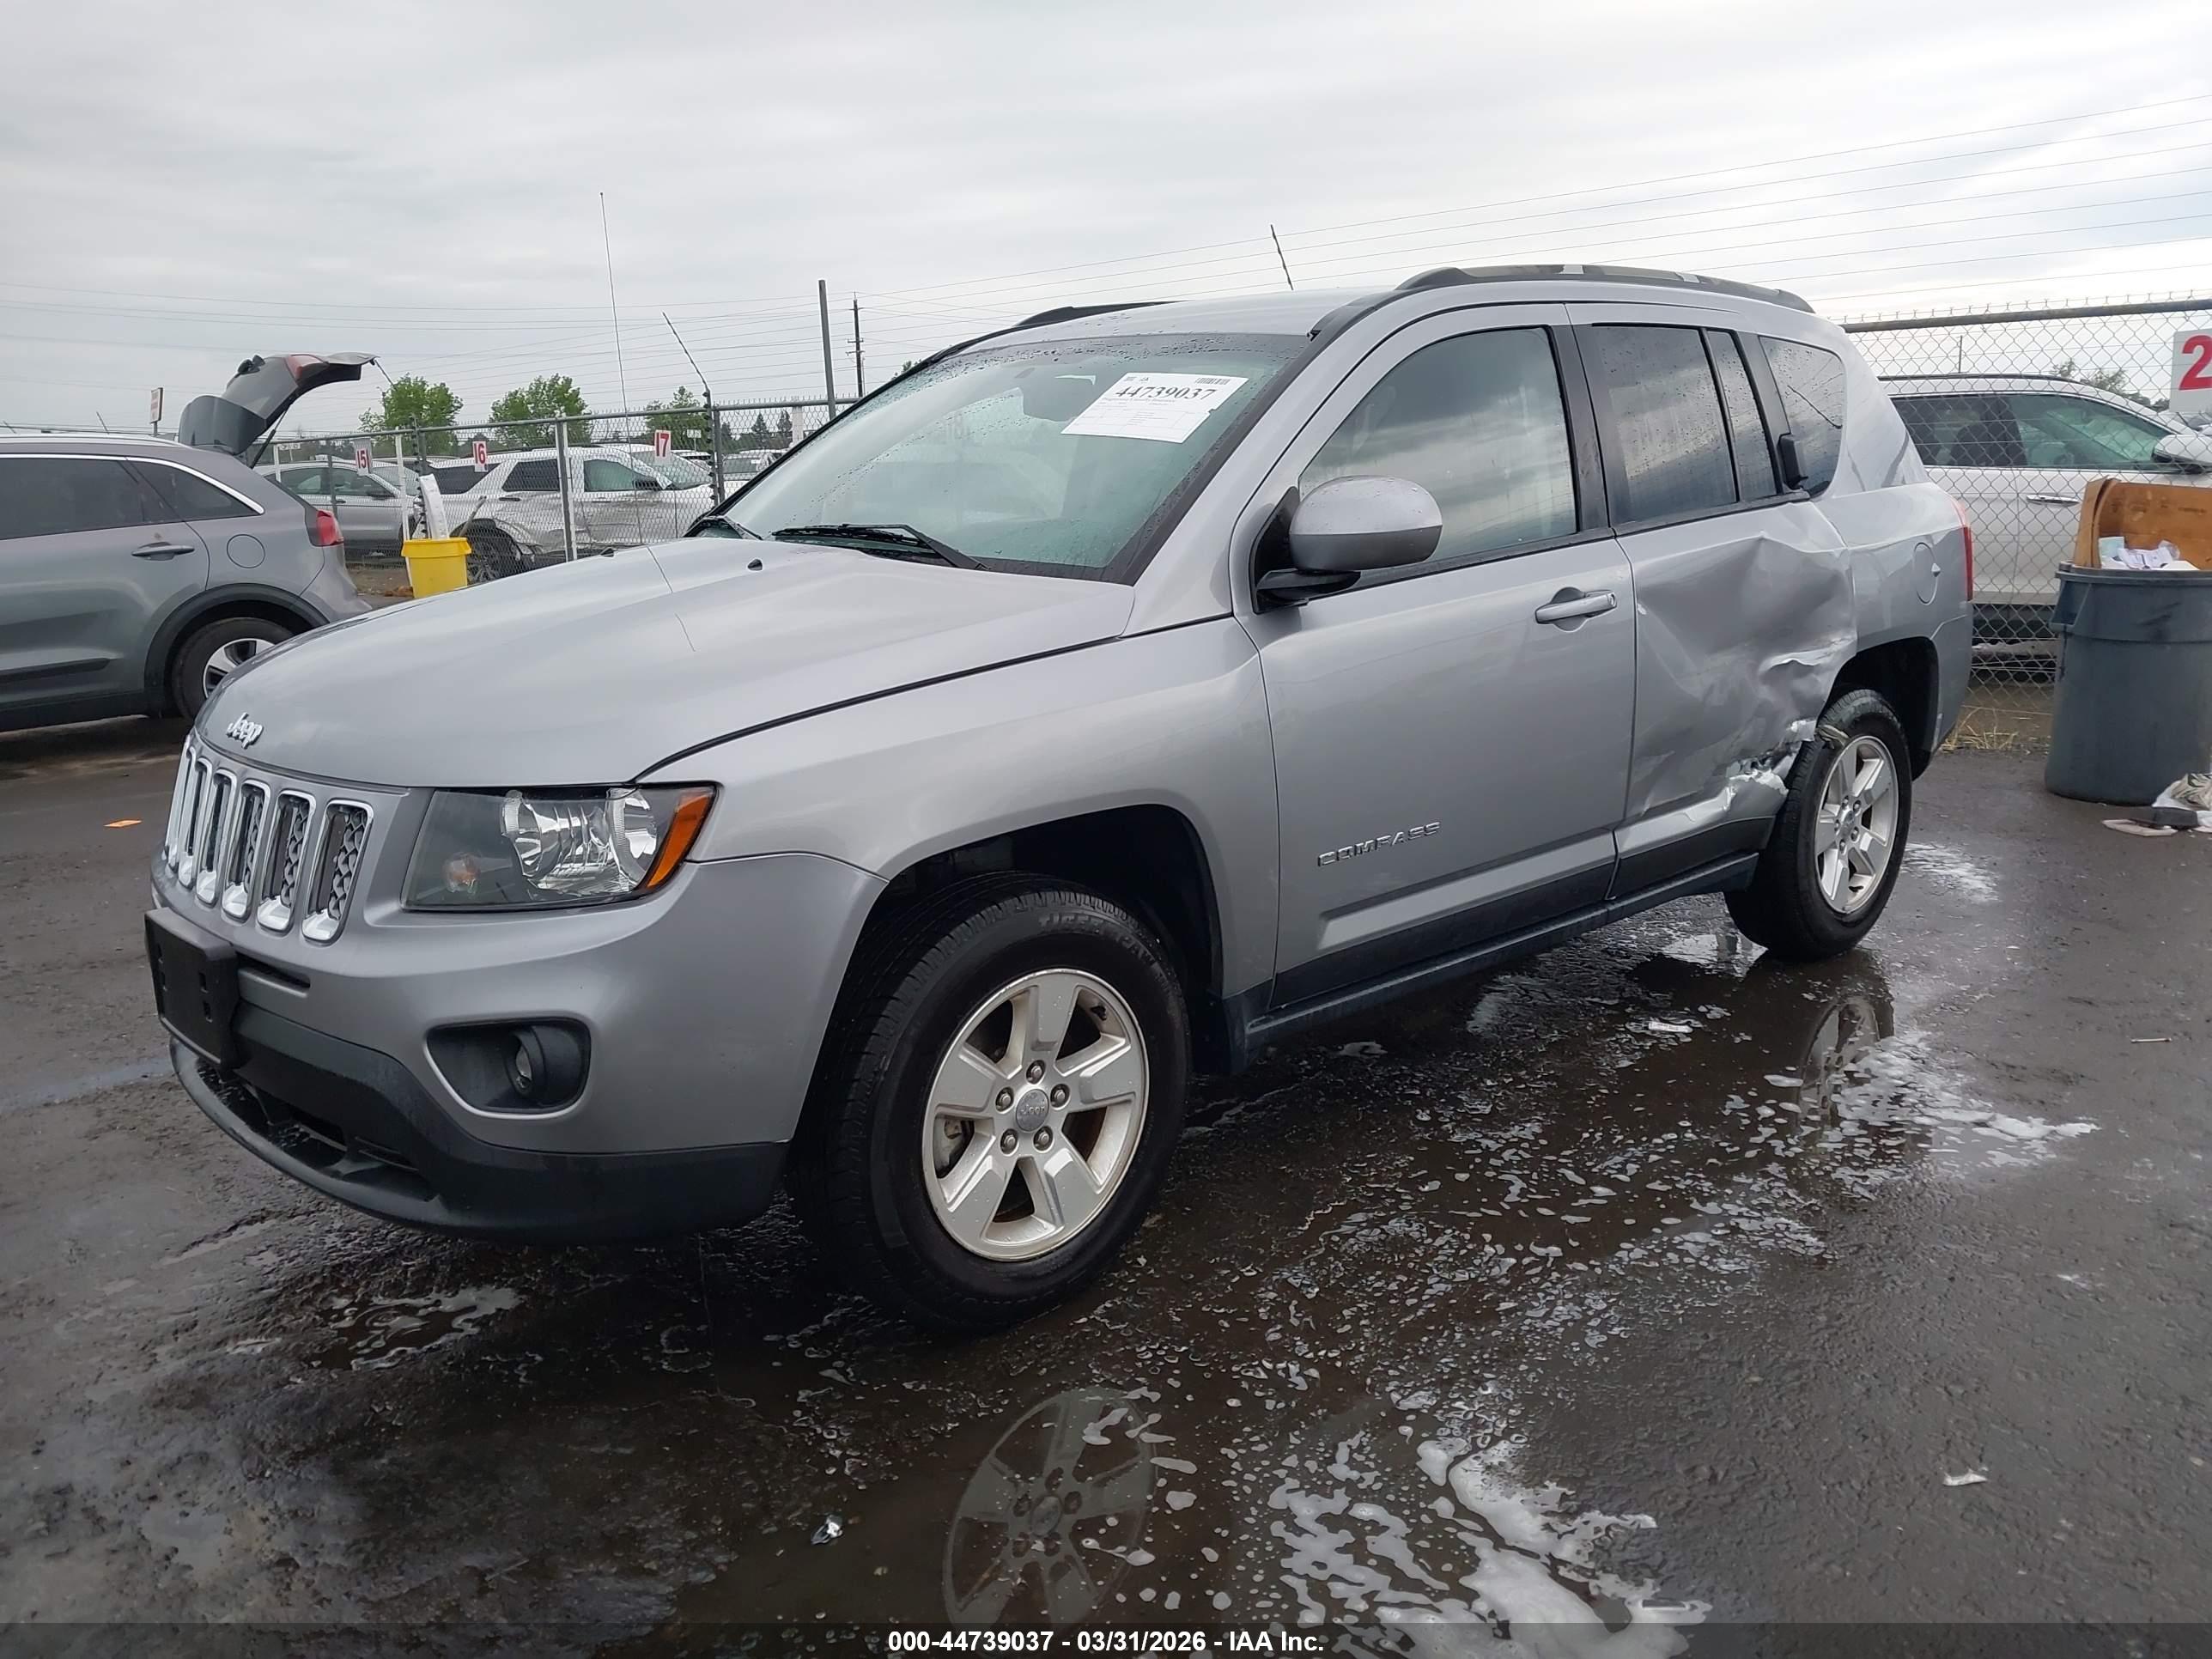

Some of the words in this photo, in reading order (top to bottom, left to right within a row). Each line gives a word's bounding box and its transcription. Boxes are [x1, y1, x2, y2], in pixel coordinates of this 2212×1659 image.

[2179, 334, 2212, 391] 2
[1115, 386, 1218, 400] 44739037
[473, 443, 486, 465] 16
[656, 432, 670, 457] 17
[226, 712, 264, 750] Jeep
[1316, 821, 1441, 868] COMPASS
